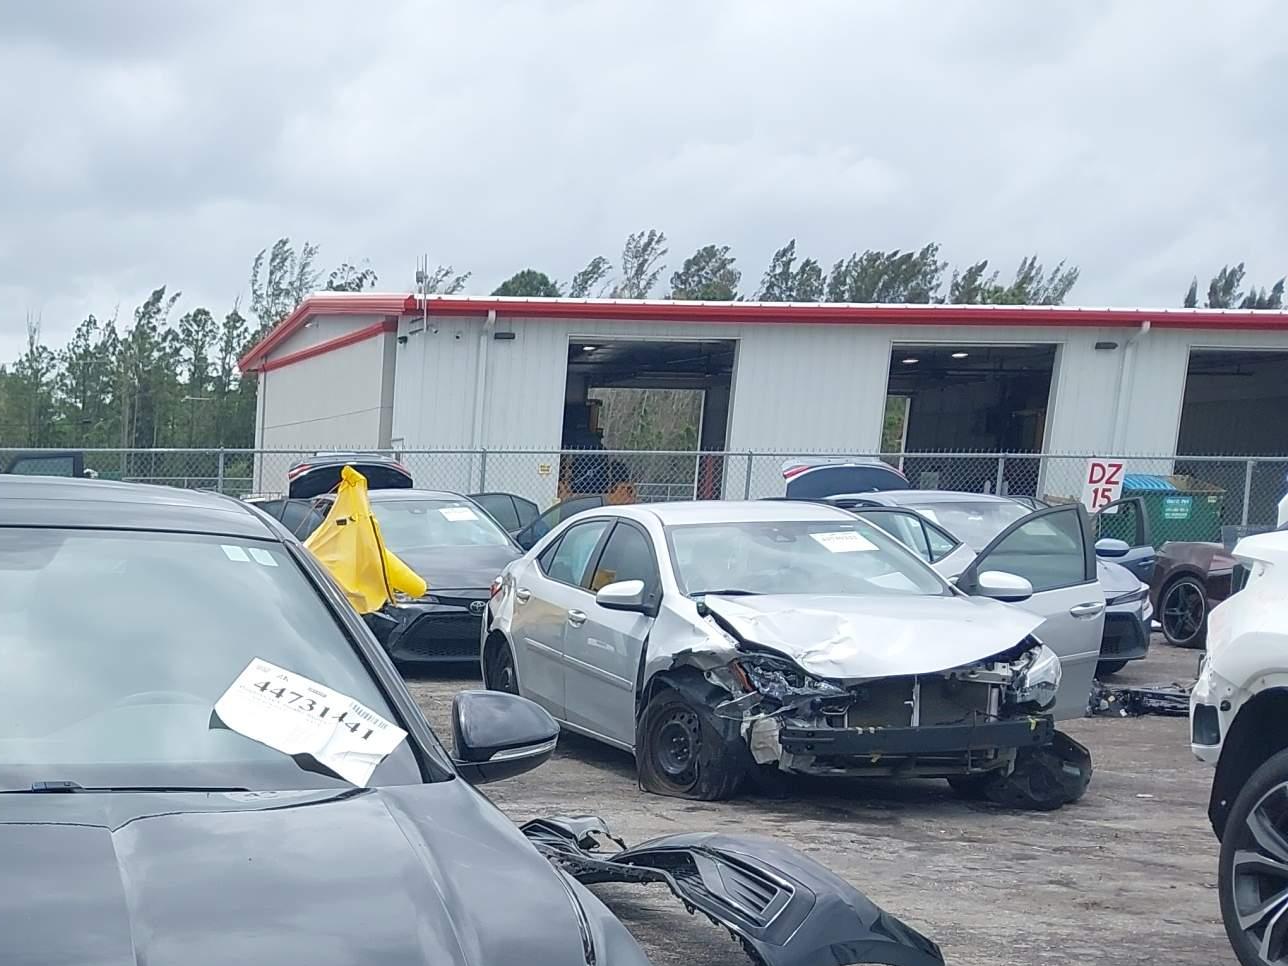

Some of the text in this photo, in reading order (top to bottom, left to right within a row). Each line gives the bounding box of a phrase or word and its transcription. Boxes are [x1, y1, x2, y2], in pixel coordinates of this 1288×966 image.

[1088, 462, 1124, 486] DZ
[1092, 487, 1113, 509] 15
[253, 680, 375, 742] 44731441
